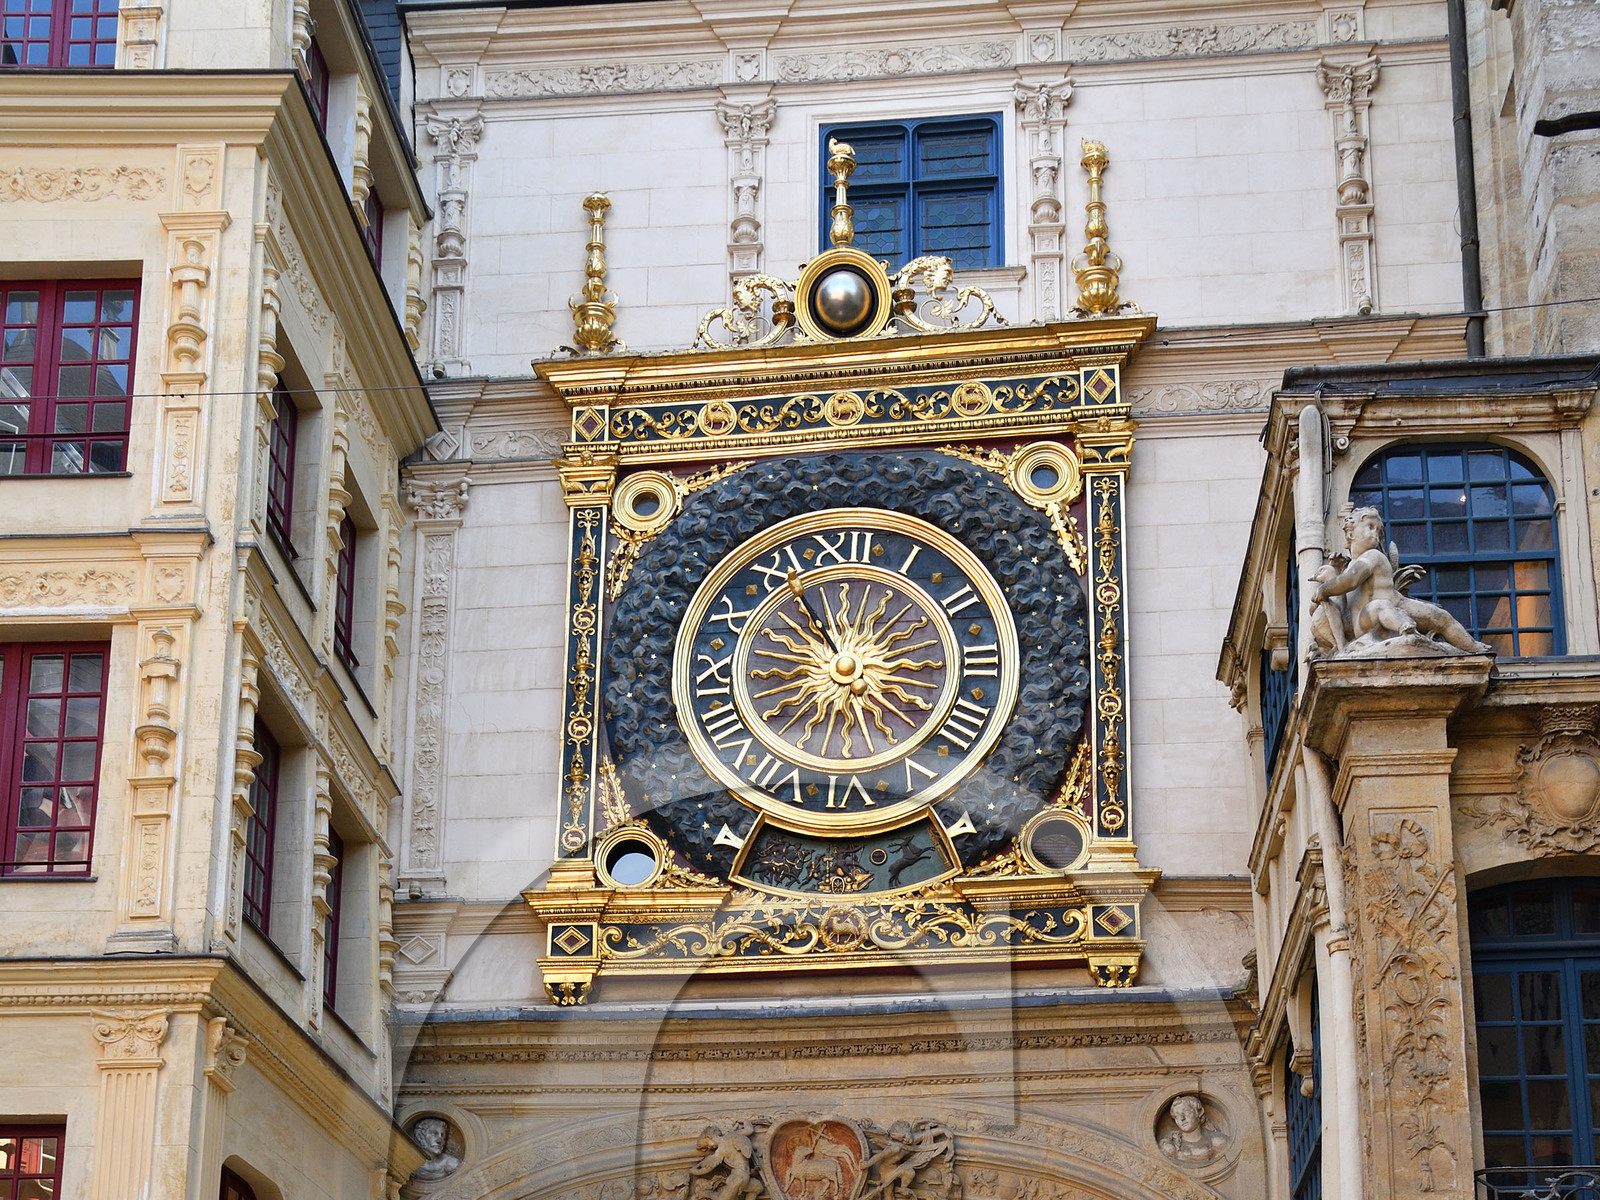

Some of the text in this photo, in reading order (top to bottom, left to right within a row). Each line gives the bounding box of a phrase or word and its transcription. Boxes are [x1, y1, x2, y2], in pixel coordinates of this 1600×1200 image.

[749, 544, 805, 591] XI
[812, 531, 873, 567] XII
[897, 544, 923, 575] I
[708, 594, 753, 634] X
[940, 583, 980, 617] II
[696, 653, 732, 698] IX
[963, 642, 999, 677] III
[700, 700, 753, 772] VIII
[937, 696, 990, 751] IIII
[747, 751, 804, 804] VII
[825, 774, 876, 809] VI
[904, 757, 939, 793] V
